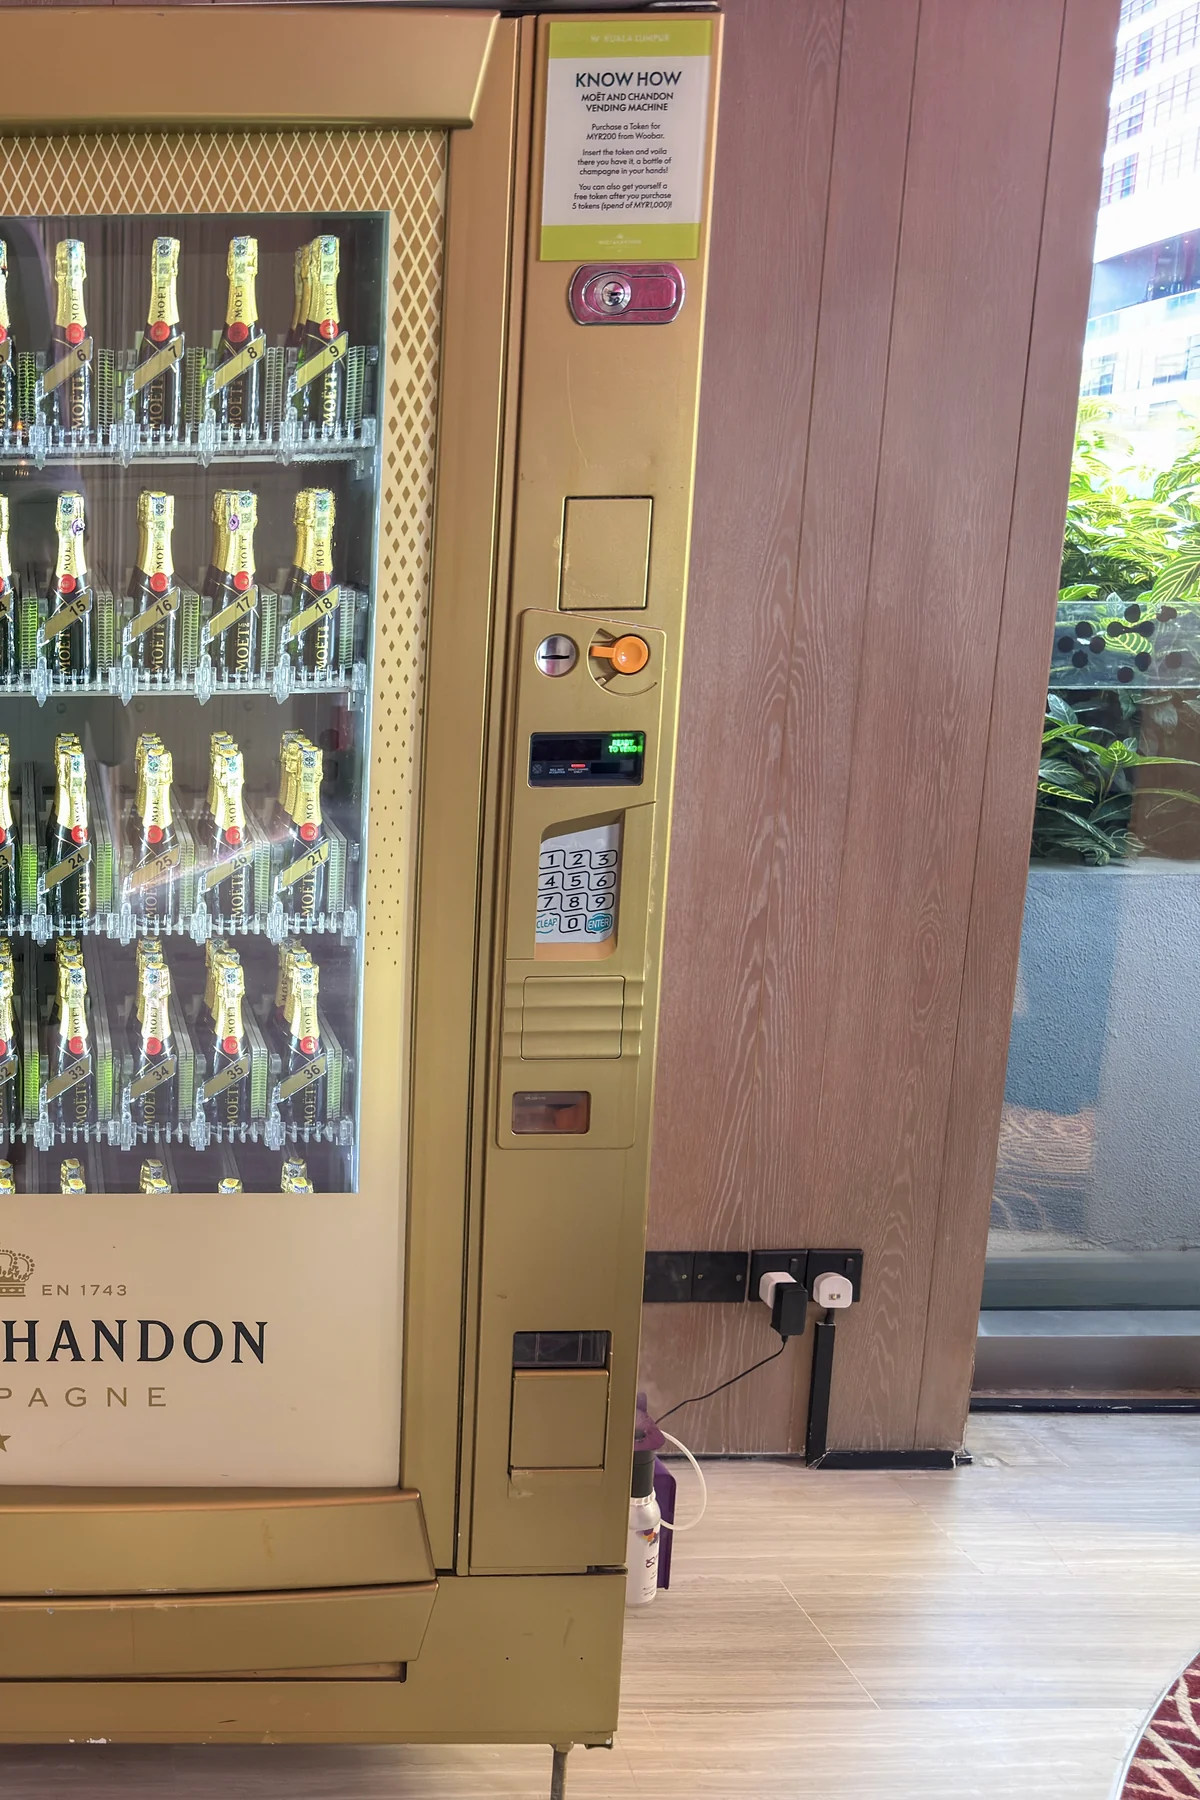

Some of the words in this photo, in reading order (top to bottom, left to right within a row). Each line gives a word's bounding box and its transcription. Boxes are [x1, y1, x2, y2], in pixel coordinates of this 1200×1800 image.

[575, 72, 634, 88] KNOW
[637, 71, 682, 87] HOW
[606, 93, 627, 101] AND
[628, 92, 674, 101] CHANDON
[586, 104, 627, 112] VENDING
[628, 103, 668, 111] MACHINE
[591, 123, 622, 131] Purchase
[629, 122, 649, 130] Token
[650, 122, 661, 130] for
[586, 132, 617, 140] MYR200
[618, 132, 634, 140] from
[635, 132, 665, 140] Woobar.
[603, 148, 614, 156] the
[615, 148, 634, 156] token
[577, 158, 595, 166] there
[596, 159, 609, 167] you
[642, 157, 663, 165] bottle
[664, 156, 672, 164] of
[579, 168, 620, 177] champagne
[628, 168, 644, 176] your
[578, 183, 591, 191] You
[622, 183, 633, 192] get
[634, 182, 661, 191] yourself
[609, 192, 626, 200] after
[626, 193, 639, 201] you
[640, 192, 672, 201] purchase
[572, 202, 577, 210] 5
[578, 202, 600, 210] tokens
[601, 202, 624, 211] (spend
[625, 201, 633, 209] of
[77, 349, 86, 362] 6
[167, 345, 178, 358] 7
[247, 346, 258, 359] 8
[329, 345, 340, 358] 9
[69, 600, 86, 617] 15
[155, 599, 172, 617] 16
[236, 596, 251, 613] 17
[315, 597, 333, 614] 18
[67, 852, 85, 870] 24
[155, 855, 173, 871] 25
[230, 854, 248, 871] 26
[307, 849, 324, 866] 27
[548, 854, 554, 865] 1
[572, 853, 583, 866] 2
[598, 854, 609, 866] 3
[544, 875, 555, 886] 4
[570, 875, 581, 887] 5
[596, 875, 607, 887] 6
[543, 896, 554, 908] 7
[569, 896, 580, 908] 8
[595, 896, 606, 908] 9
[588, 918, 610, 928] ENTER
[67, 1065, 86, 1081] 33
[152, 1065, 170, 1081] 34
[226, 1064, 244, 1081] 35
[303, 1064, 321, 1081] 36
[41, 1284, 70, 1296] EN
[80, 1284, 128, 1297] 1743
